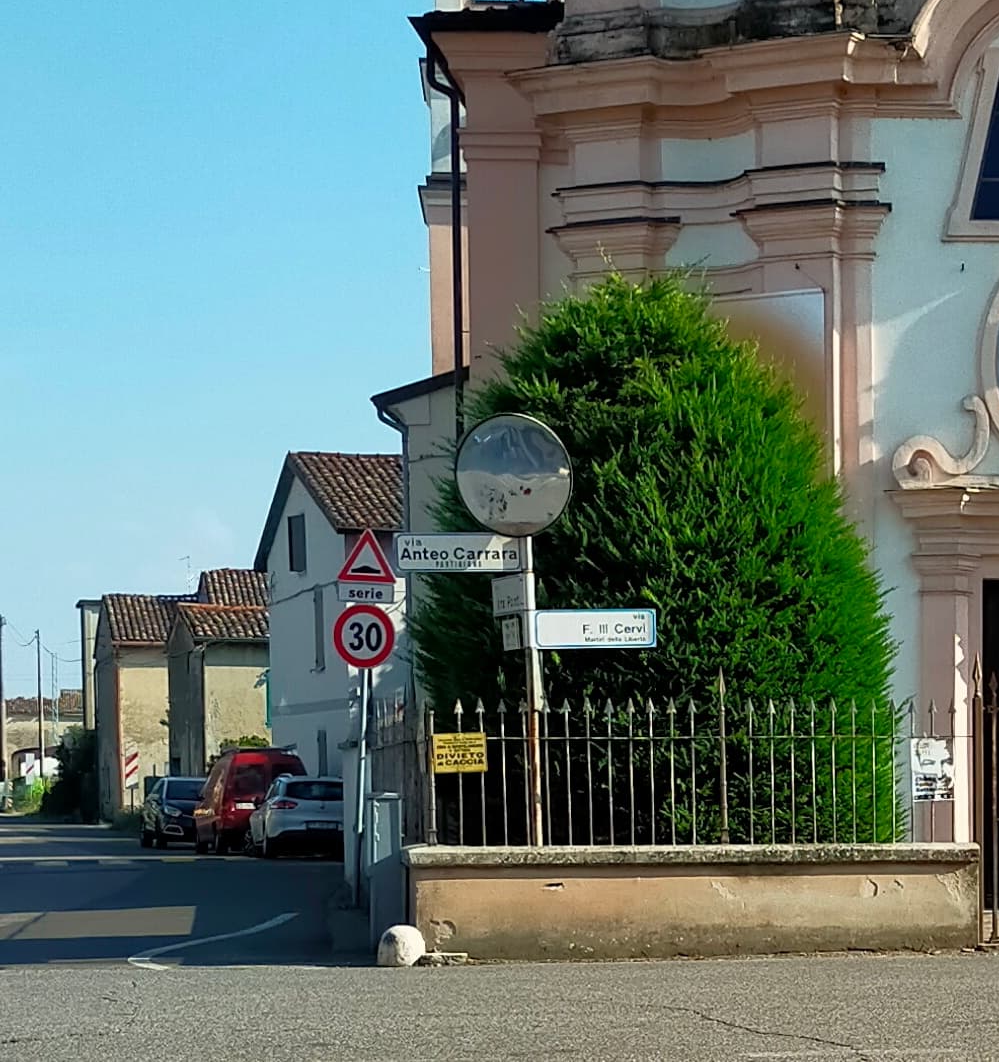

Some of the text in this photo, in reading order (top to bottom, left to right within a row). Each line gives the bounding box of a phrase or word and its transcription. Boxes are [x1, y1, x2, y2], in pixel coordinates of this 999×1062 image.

[404, 538, 422, 547] via
[400, 547, 518, 561] Anteo Carrara
[348, 587, 383, 600] serie
[614, 622, 647, 635] Cervi
[348, 621, 383, 652] 30
[445, 758, 485, 766] CACCIA
